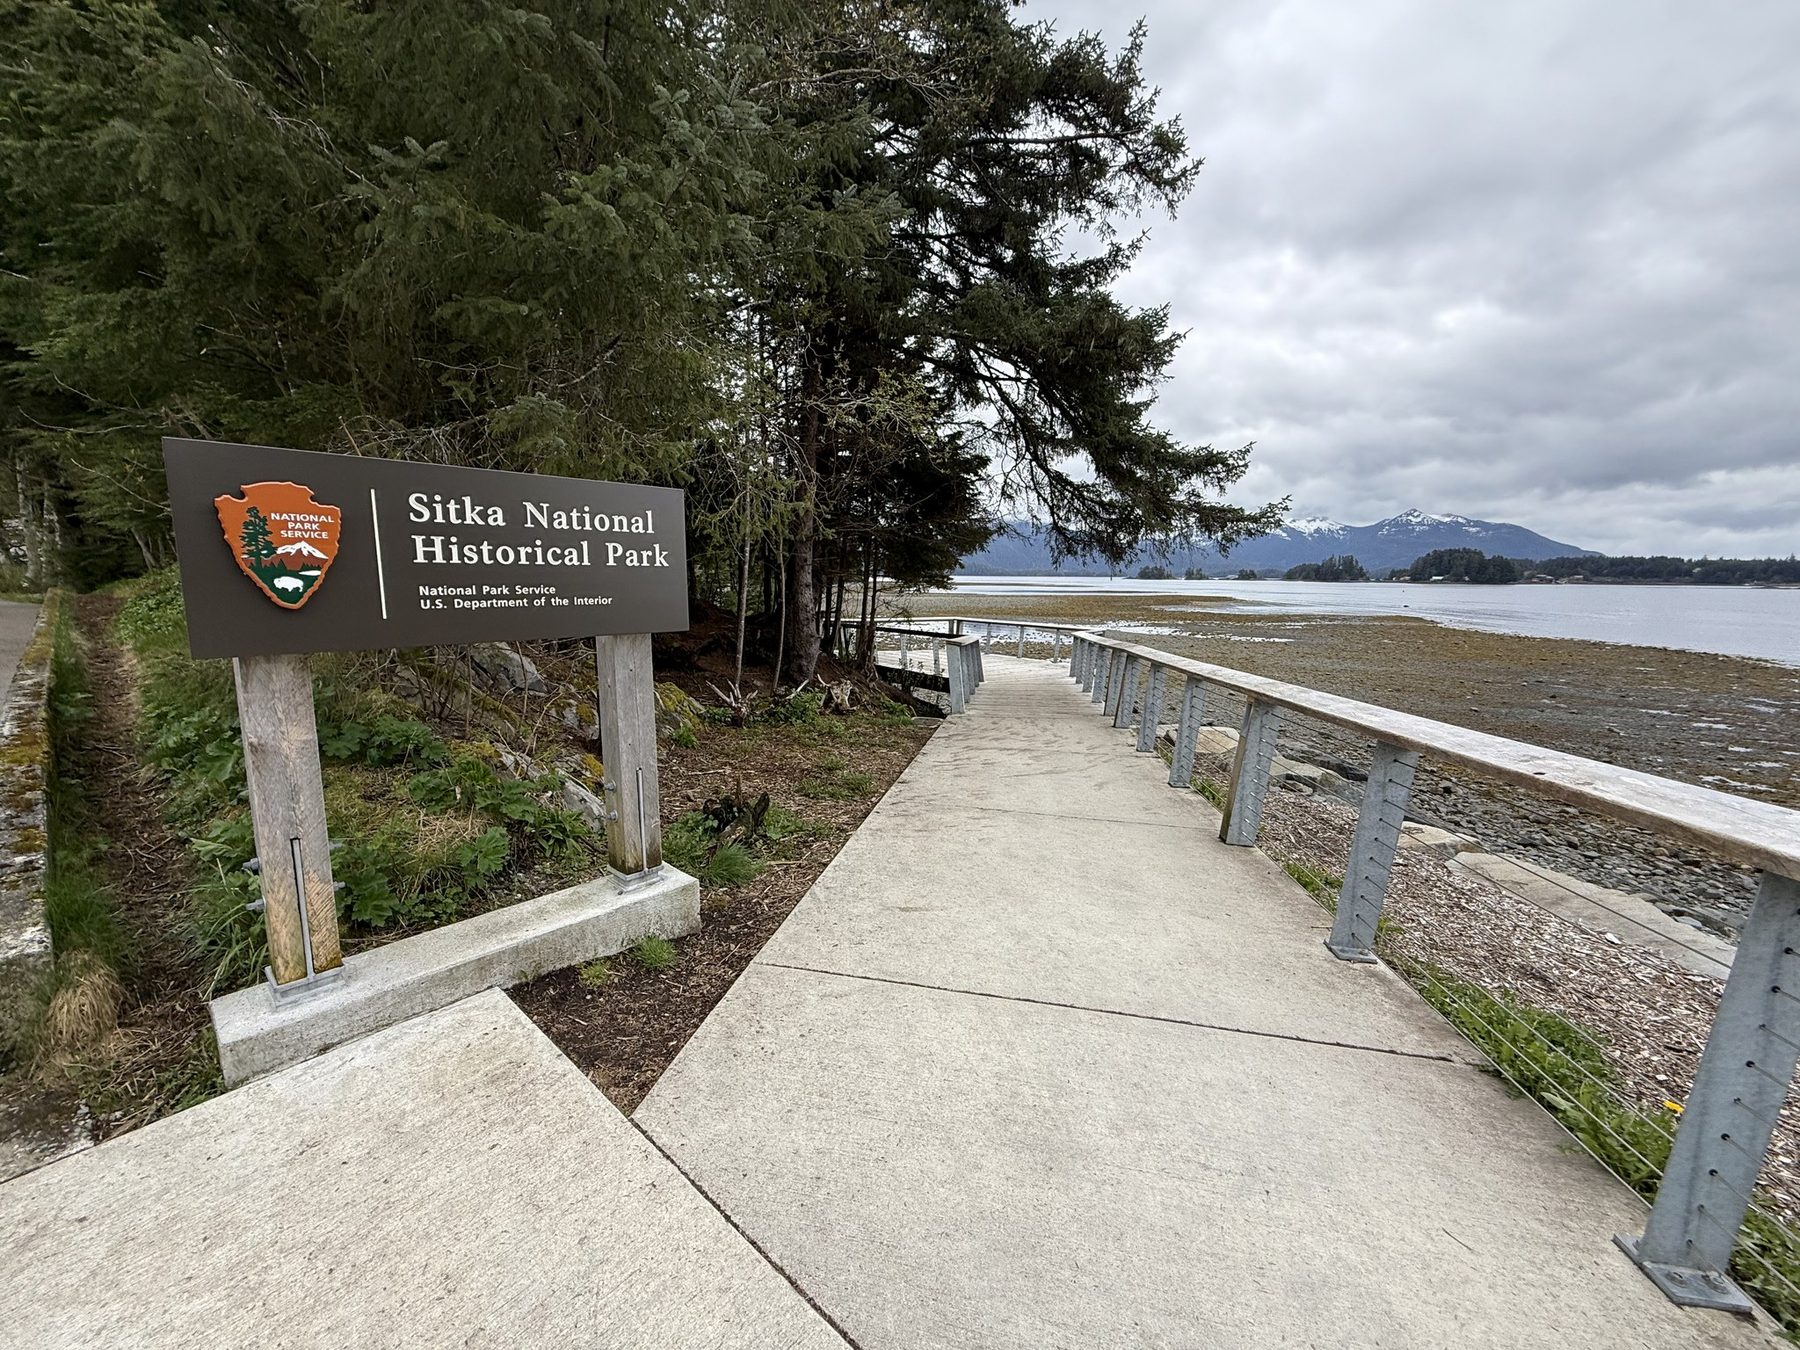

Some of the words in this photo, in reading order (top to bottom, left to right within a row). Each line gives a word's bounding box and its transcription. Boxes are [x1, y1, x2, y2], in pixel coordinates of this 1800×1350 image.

[271, 513, 335, 523] NATIONAL
[408, 492, 507, 527] Sitka
[522, 501, 655, 534] National
[287, 521, 320, 531] PARK
[280, 530, 329, 539] SERVICE
[410, 534, 591, 566] Historical
[605, 542, 670, 567] Park
[418, 584, 477, 596] National
[482, 584, 510, 595] Park
[515, 584, 556, 595] Service
[420, 598, 448, 610] U.S.
[453, 598, 529, 611] Department
[533, 596, 546, 607] of
[550, 596, 569, 606] the
[574, 595, 613, 606] Interior
